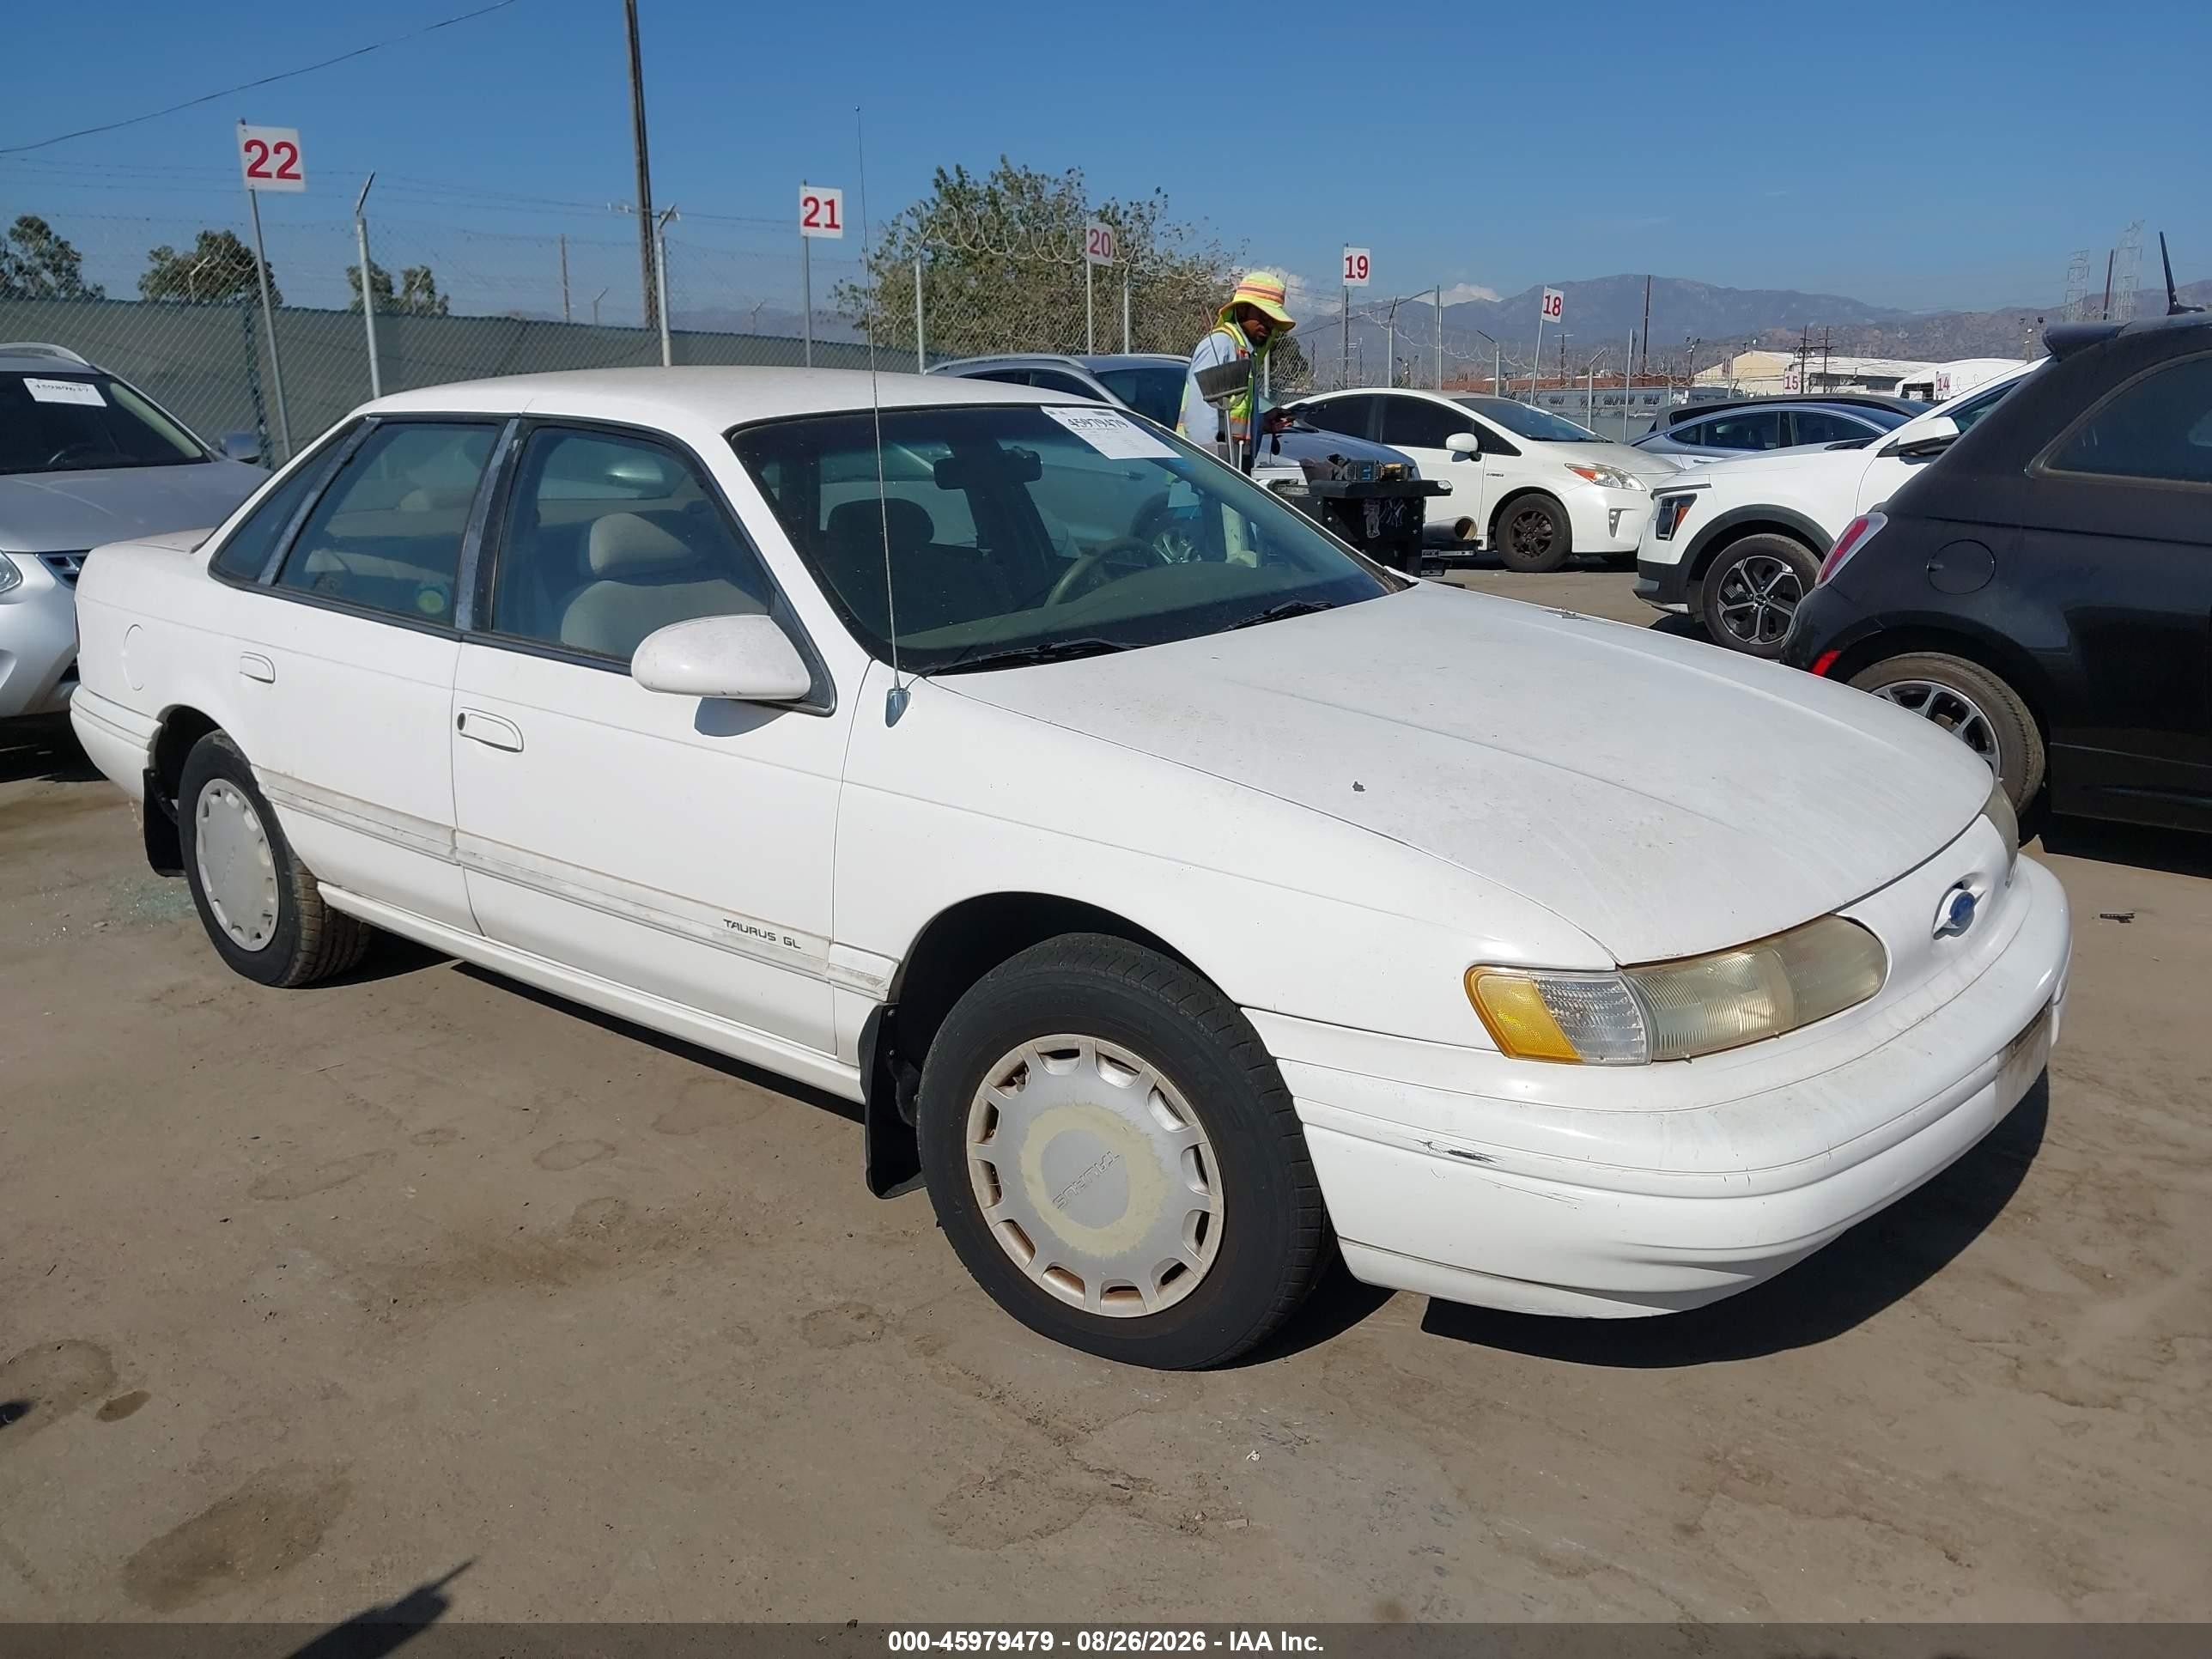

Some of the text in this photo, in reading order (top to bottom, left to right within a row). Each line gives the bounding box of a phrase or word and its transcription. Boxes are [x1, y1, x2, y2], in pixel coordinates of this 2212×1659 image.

[244, 139, 301, 179] 22
[803, 196, 841, 229] 21
[1089, 228, 1111, 258] 20
[1345, 255, 1368, 279] 19
[1543, 295, 1561, 317] 18
[1784, 374, 1799, 390] 15
[1936, 376, 1950, 392] 14
[1067, 418, 1129, 428] 45979479
[723, 918, 802, 950] TAURUS GL
